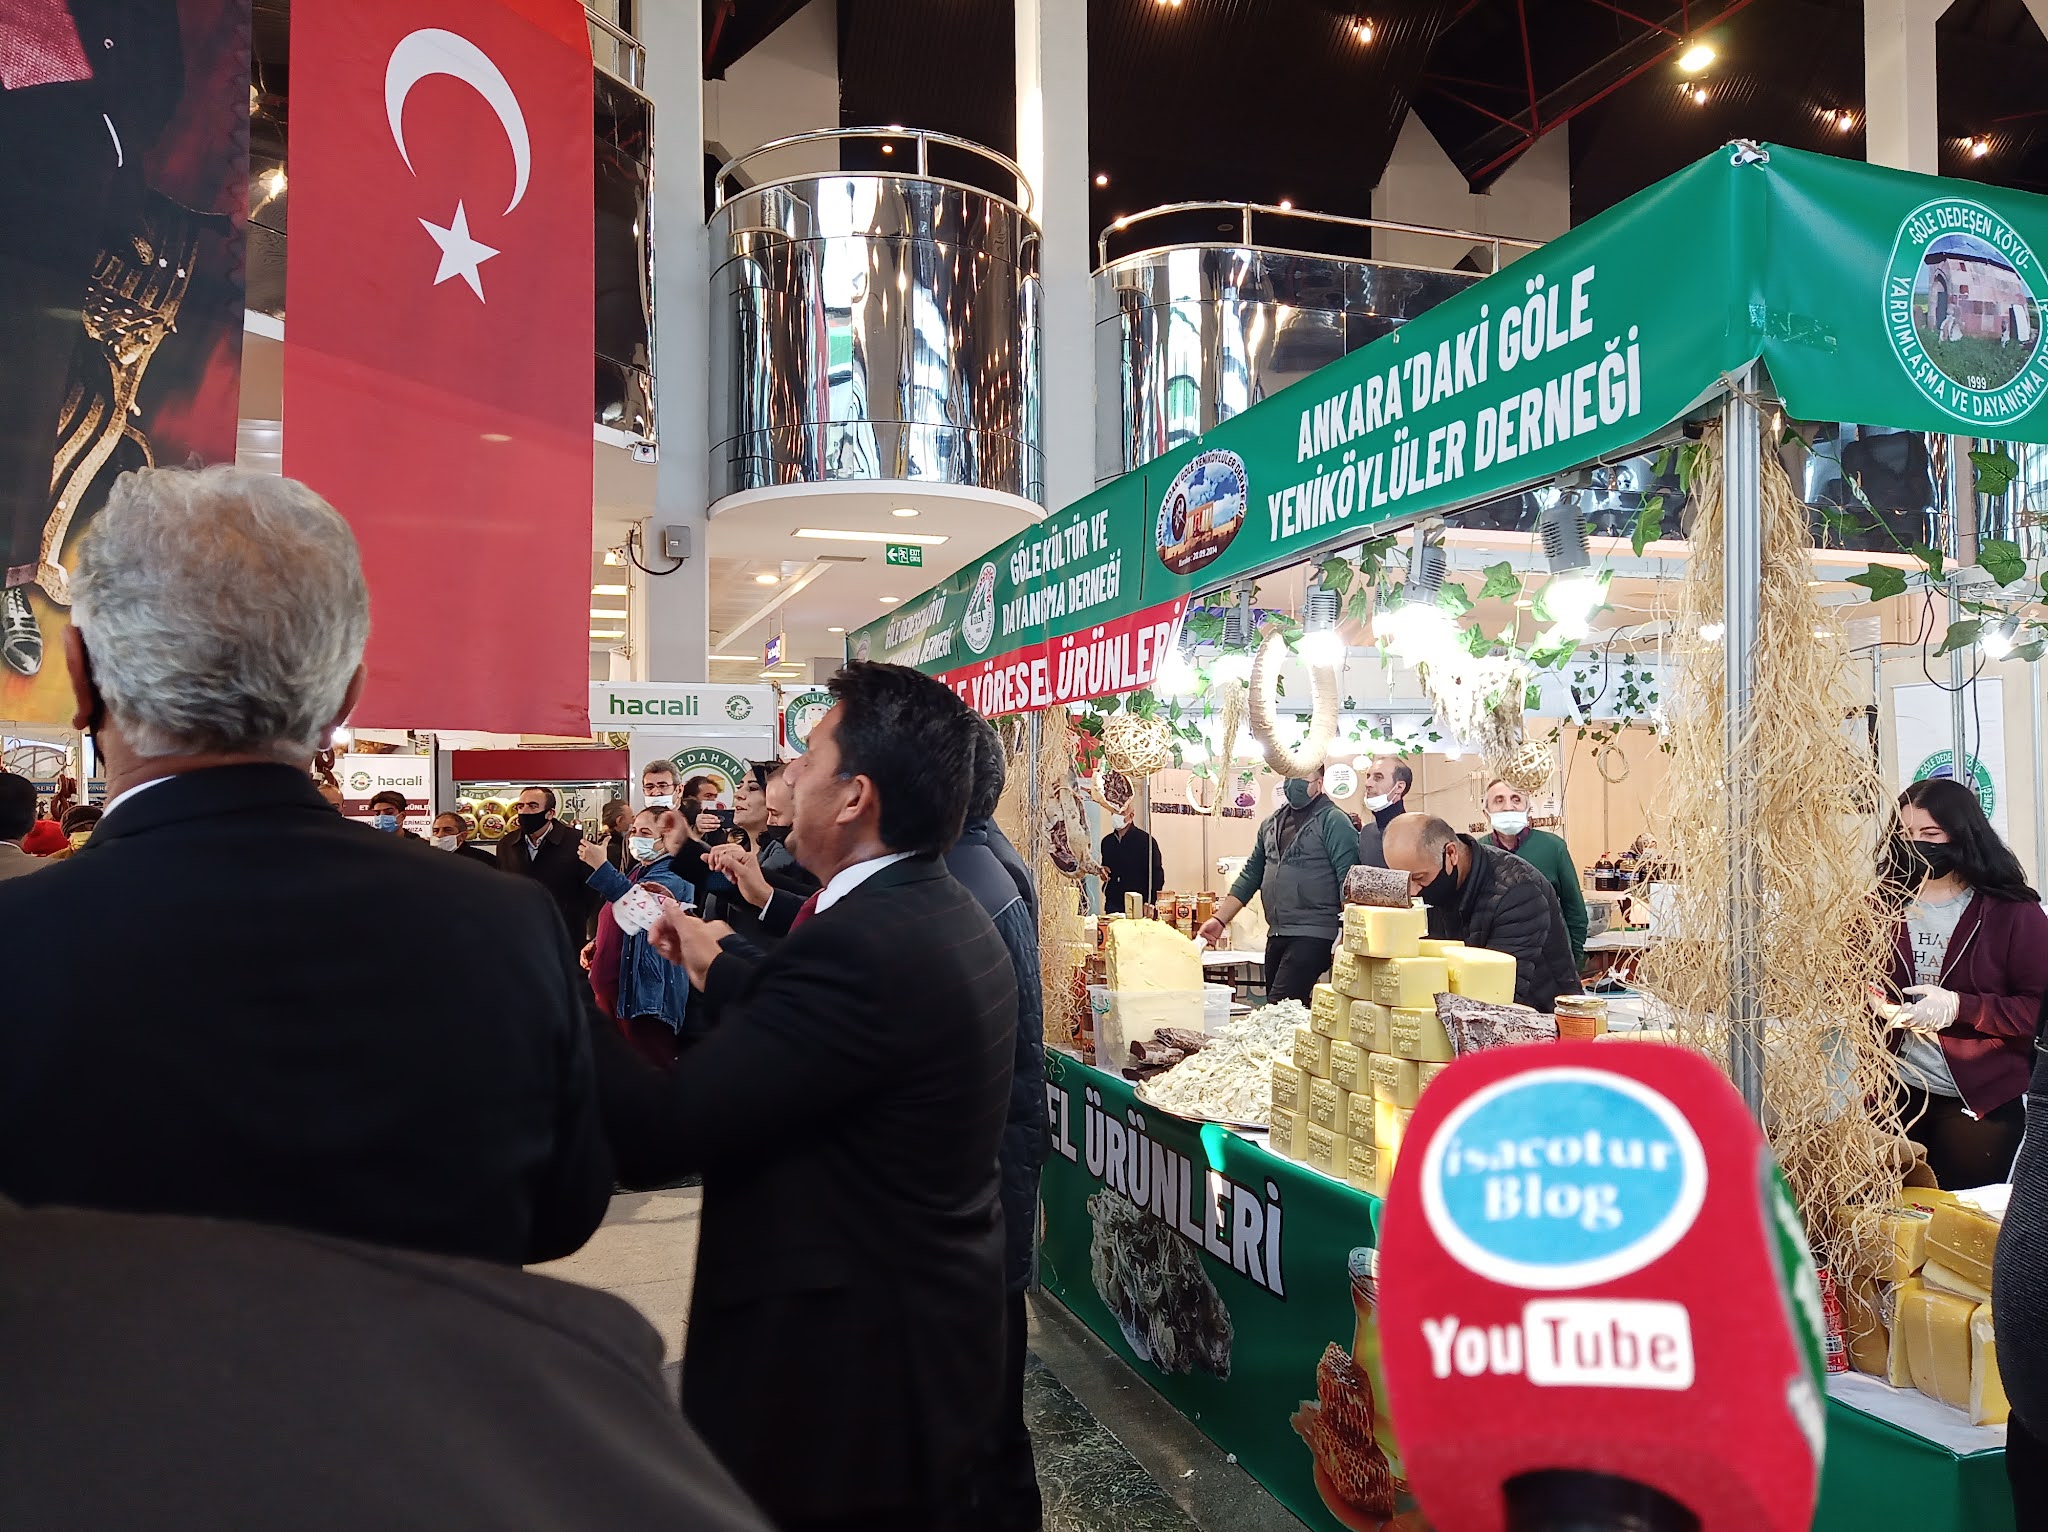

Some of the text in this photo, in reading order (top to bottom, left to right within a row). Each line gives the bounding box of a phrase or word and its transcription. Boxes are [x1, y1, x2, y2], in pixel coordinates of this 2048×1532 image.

[1936, 207, 1992, 237] DEDEŞEN
[1297, 264, 1596, 463] ANKARA'DAKİ GÖLE
[1890, 276, 2045, 417] YARDIMLAŞMA VE DAYANIŞMA
[1966, 375, 1988, 390] 1999
[1267, 325, 1641, 542] YENİKÖYLÜLER DERNEĞİ
[1010, 509, 1109, 586] GÖLE KÜLTÜR VE
[1002, 581, 1066, 636] DAYANIŞMA
[1068, 548, 1121, 614] DERNEĞİ
[971, 660, 1052, 717] YÖRESEL
[1053, 601, 1181, 700] ÜRÜNLERİ
[676, 753, 741, 777] RDAHAN
[1935, 752, 1953, 765] DEDE
[1444, 1128, 1677, 1178] isacotur
[1085, 1087, 1285, 1298] ÜRÜNLERİ
[1483, 1174, 1624, 1233] Blog
[1421, 1314, 1680, 1380] YouTube
